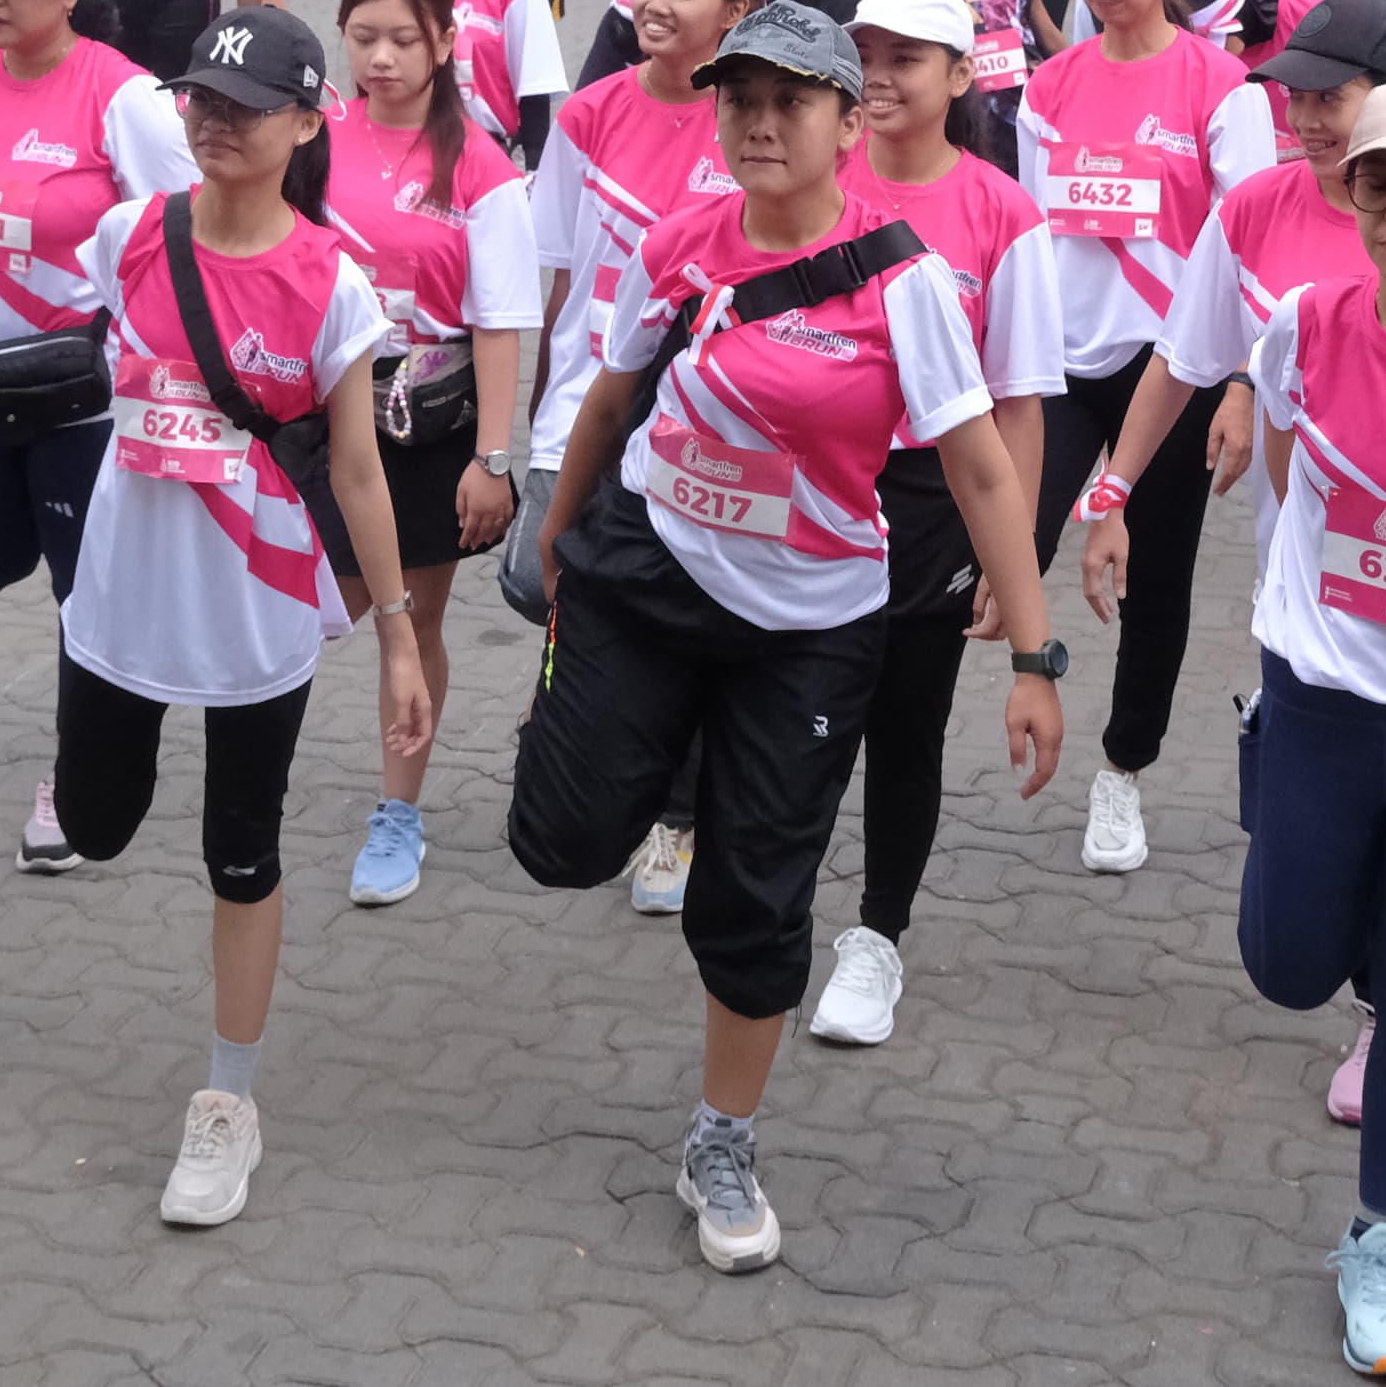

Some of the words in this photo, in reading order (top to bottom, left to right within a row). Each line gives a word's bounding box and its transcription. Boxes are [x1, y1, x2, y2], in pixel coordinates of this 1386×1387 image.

[210, 26, 254, 66] NY
[1068, 182, 1133, 206] 6432
[795, 324, 857, 349] smartfren
[259, 351, 306, 374] smartfr
[142, 408, 222, 444] 6245
[671, 476, 753, 524] 6217
